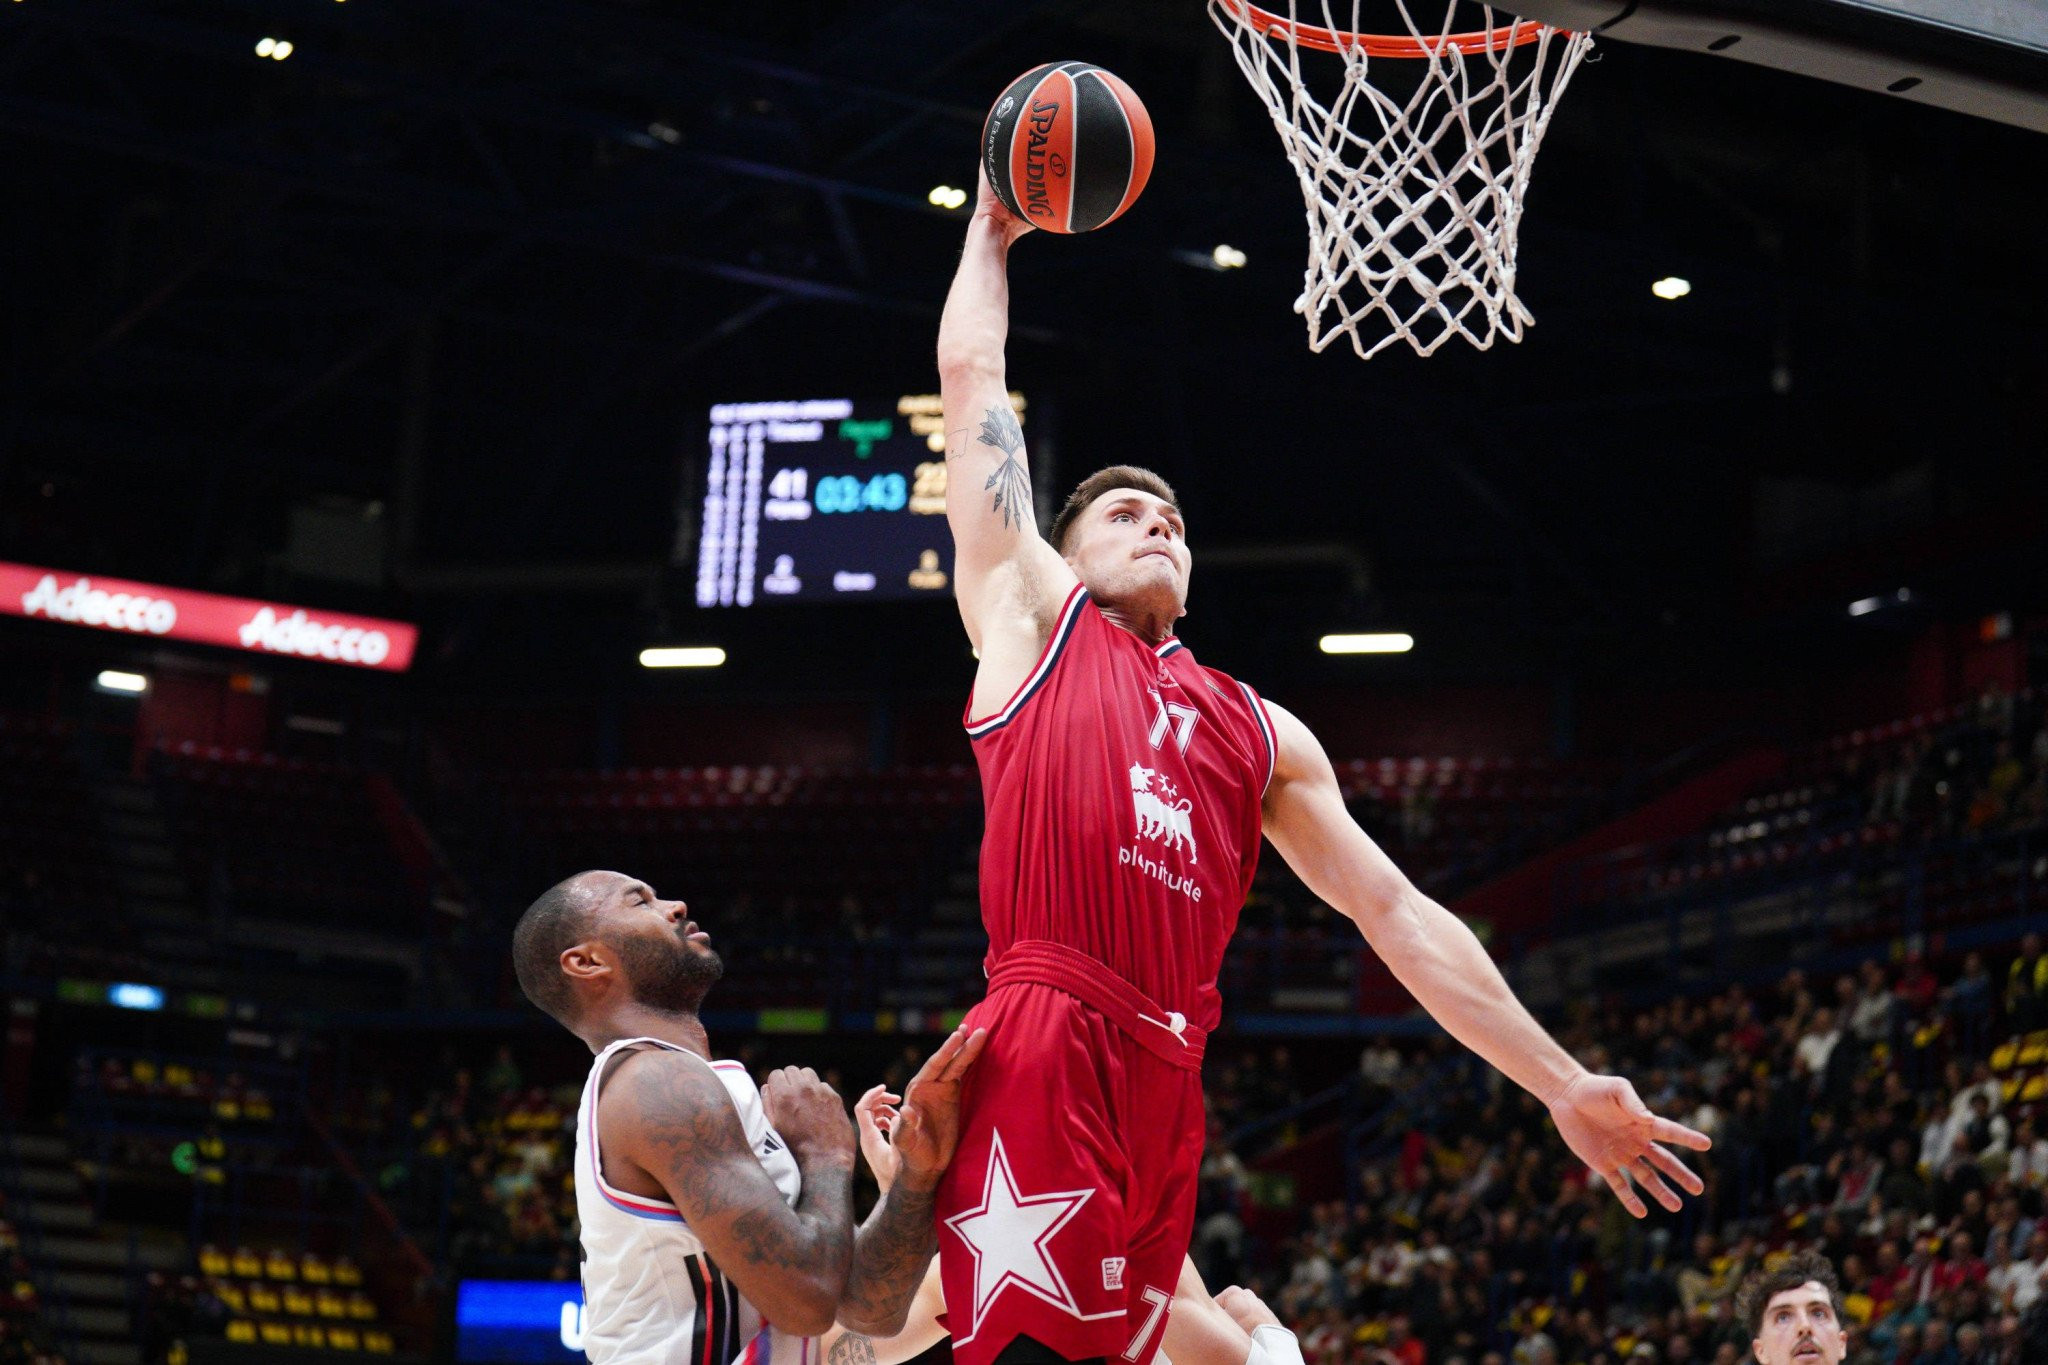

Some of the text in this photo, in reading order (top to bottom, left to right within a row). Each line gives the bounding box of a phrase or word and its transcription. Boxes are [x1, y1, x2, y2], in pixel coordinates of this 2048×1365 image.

[1026, 100, 1059, 217] SPALDING
[768, 467, 808, 500] 41
[815, 472, 907, 514] 03:43
[22, 573, 177, 635] Adecco
[238, 606, 390, 665] Adecco
